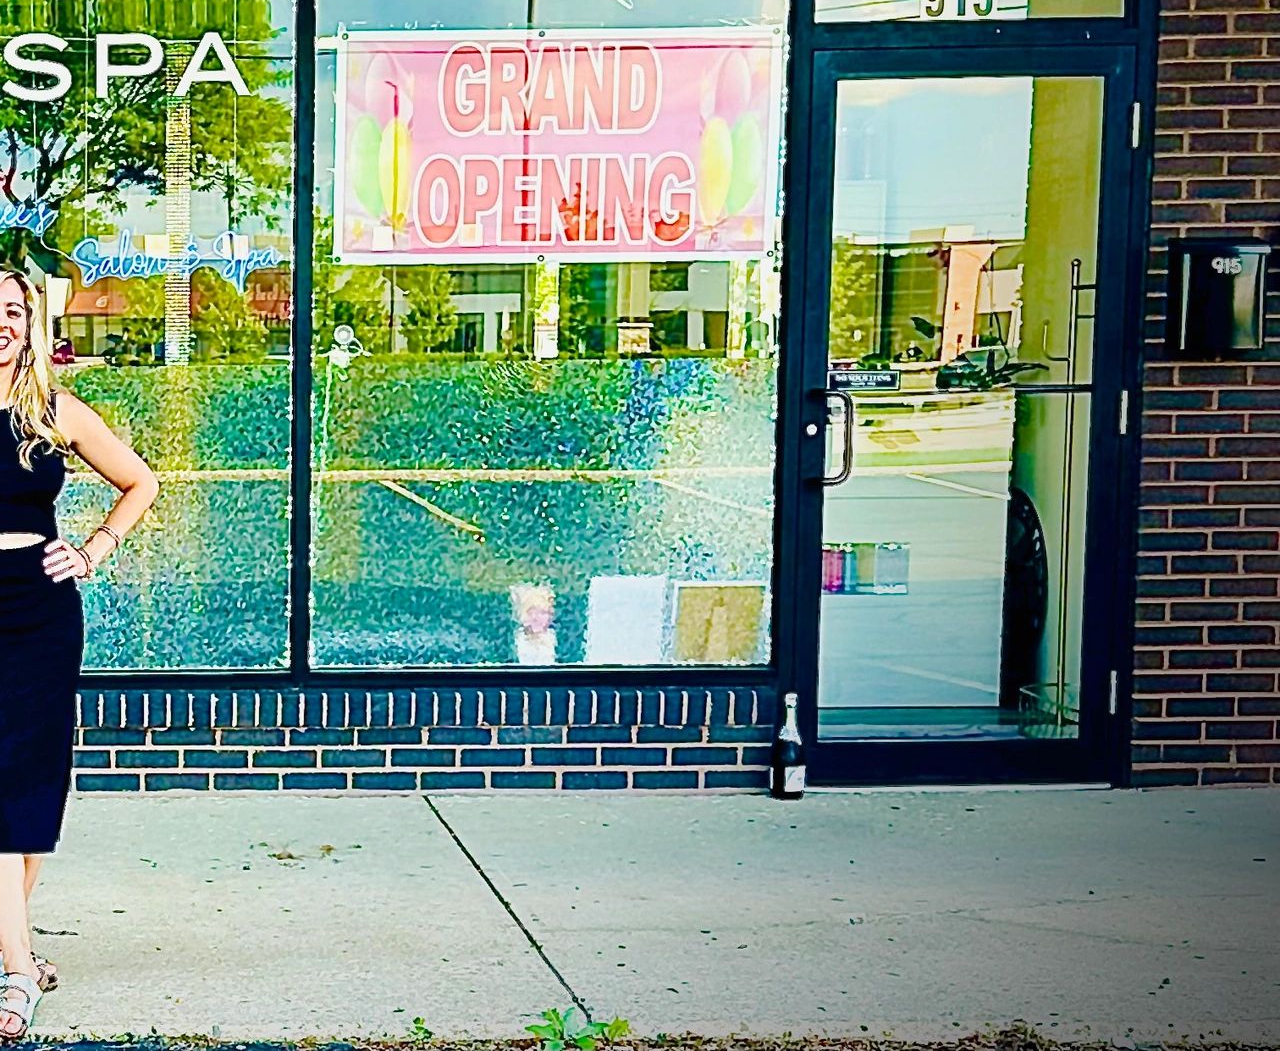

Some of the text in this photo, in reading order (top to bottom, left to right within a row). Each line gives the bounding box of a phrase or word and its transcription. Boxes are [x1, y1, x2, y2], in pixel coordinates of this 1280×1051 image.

[2, 31, 252, 103] SPA
[439, 41, 662, 137] GRAND
[413, 151, 696, 248] OPENING
[71, 227, 170, 287] Salon
[213, 230, 283, 295] Spa
[1210, 256, 1243, 275] 915
